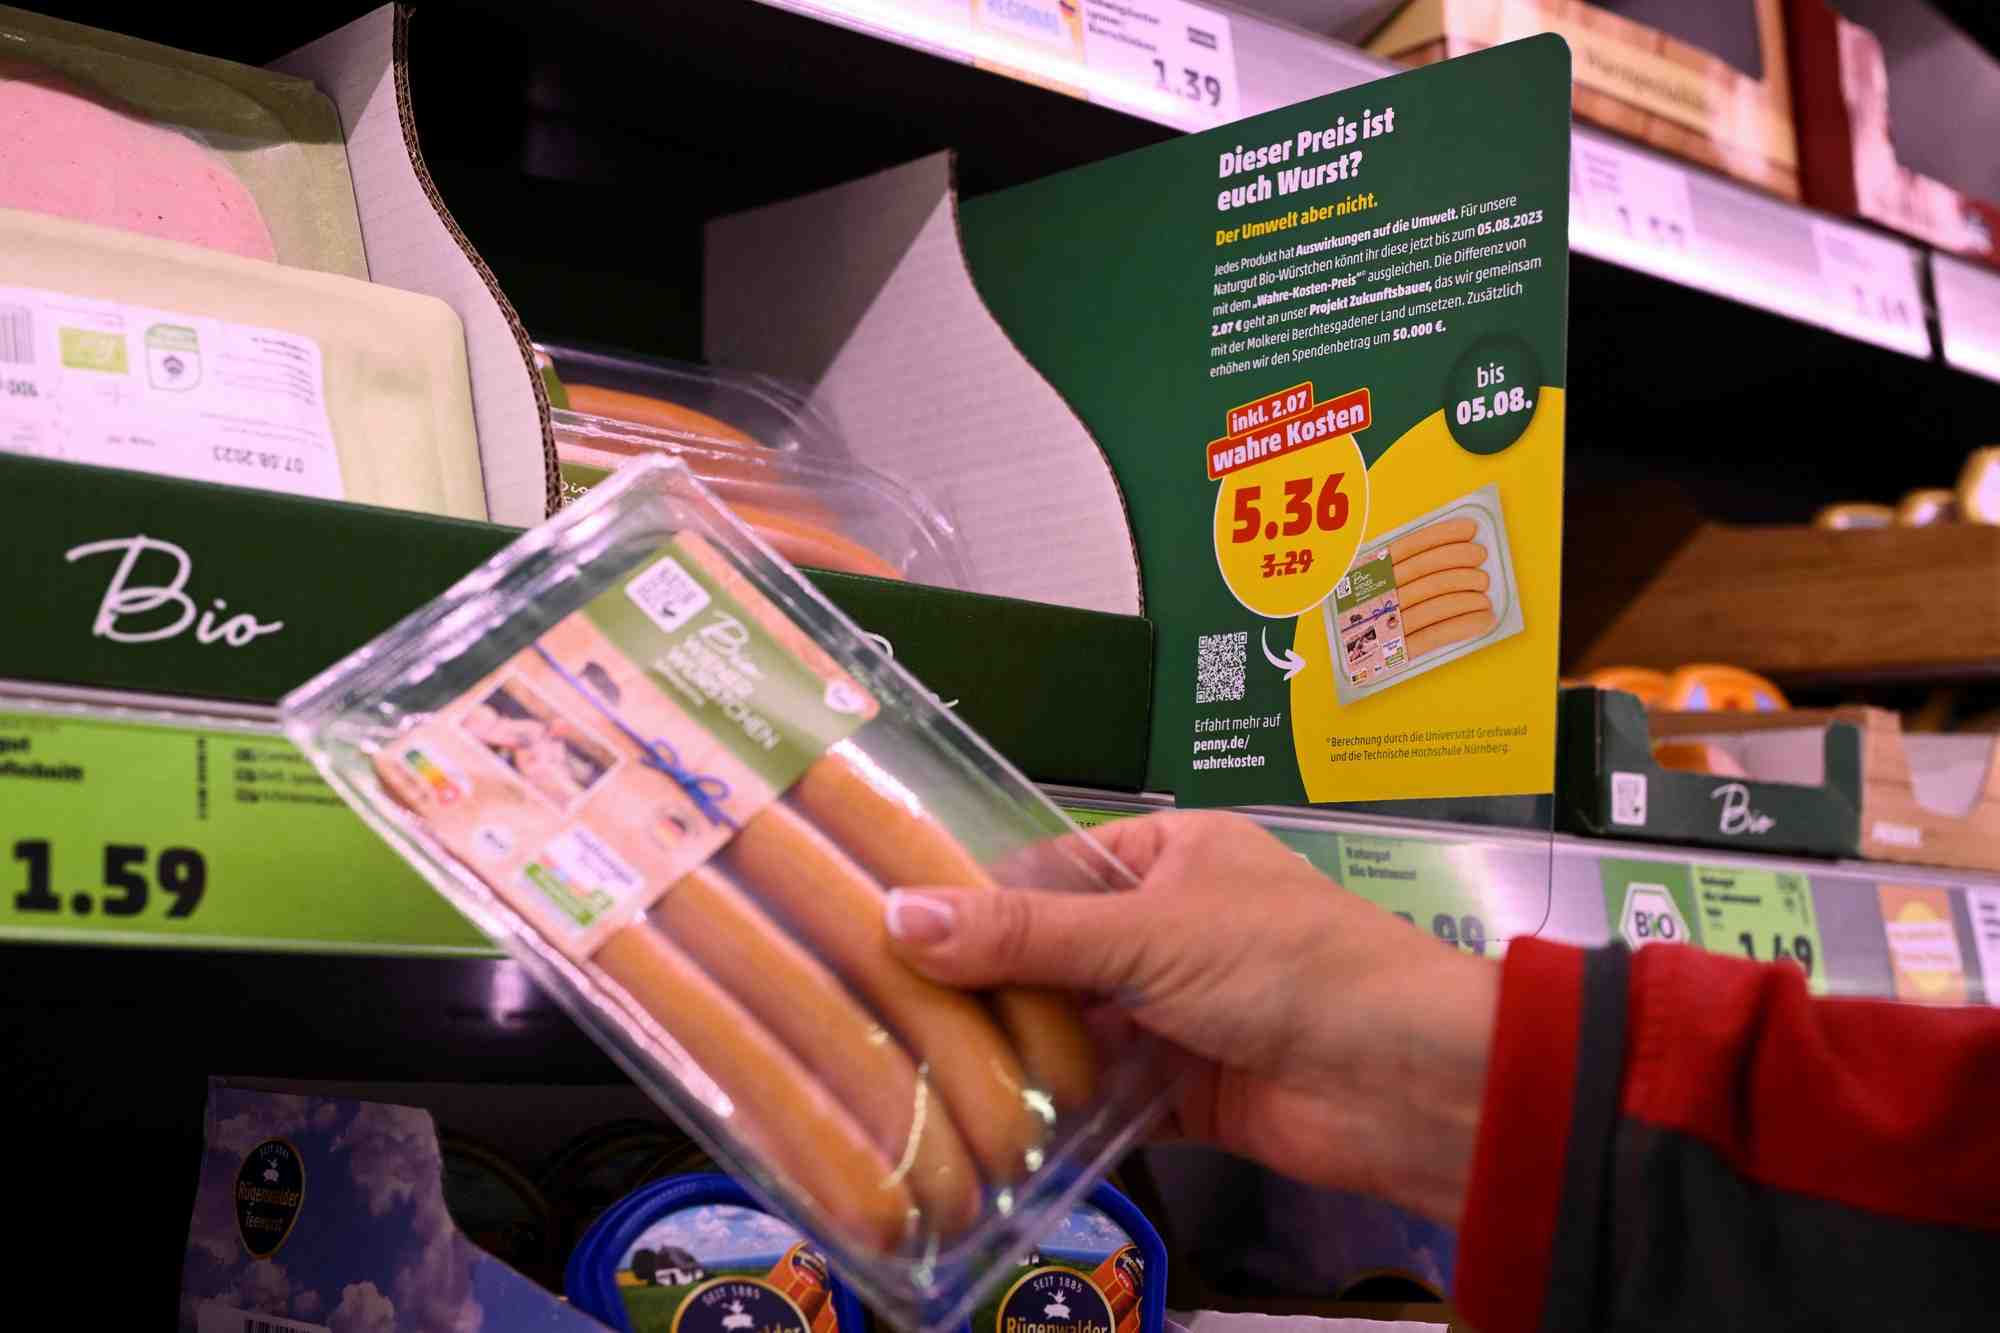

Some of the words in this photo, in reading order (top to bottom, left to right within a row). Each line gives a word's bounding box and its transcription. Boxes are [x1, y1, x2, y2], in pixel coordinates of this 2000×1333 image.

[1153, 58, 1222, 107] 1.39
[1219, 145, 1293, 178] Dieser
[1297, 116, 1357, 156] Preis
[1362, 107, 1395, 139] ist
[1217, 174, 1272, 211] euch
[1278, 151, 1363, 195] Wurst?
[1215, 262, 1239, 277] Jedes
[1241, 252, 1278, 270] Produkt
[1279, 247, 1294, 261] hat
[1296, 231, 1370, 257] Auswirkungen
[1373, 224, 1391, 240] auf
[1393, 219, 1409, 234] die
[1411, 208, 1459, 230] Umwelt.
[1461, 203, 1478, 218] Für
[1480, 195, 1517, 214] unsere
[1216, 228, 1239, 246] Der
[1242, 212, 1298, 239] Umwelt
[1301, 204, 1335, 225] aber
[1337, 192, 1378, 215] nicht.
[1212, 302, 1229, 317] mit
[1230, 298, 1251, 313] dem
[1368, 260, 1432, 282] ausgleichen.
[1434, 254, 1452, 268] Die
[1454, 242, 1504, 263] Differenz
[1505, 238, 1527, 253] von
[1214, 275, 1257, 297] Naturgut
[1259, 258, 1333, 287] Bio-Würstchen
[1334, 250, 1363, 268] könnt
[1365, 247, 1378, 261] ihr
[1381, 242, 1411, 258] diese
[1409, 236, 1432, 254] jetzt
[1435, 231, 1450, 246] bis
[1452, 227, 1475, 242] zum
[1477, 210, 1543, 236] 05.08.2023
[1211, 321, 1234, 337] 2.07
[1235, 319, 1243, 332] €
[1243, 315, 1265, 333] geht
[1266, 313, 1279, 325] an
[1281, 306, 1308, 322] unser
[1309, 295, 1348, 317] Projekt
[1350, 280, 1432, 308] Zukunftsbauer,
[1434, 275, 1453, 289] das
[1455, 269, 1474, 285] wir
[1475, 257, 1542, 284] gemeinsam
[1211, 343, 1227, 357] mit
[1228, 339, 1246, 353] der
[1247, 331, 1290, 351] Molkerei
[1292, 312, 1378, 341] Berchtesgadener
[1381, 304, 1406, 322] Land
[1408, 296, 1465, 317] umsetzen.
[1467, 281, 1523, 305] Zusätzlich
[1210, 357, 1250, 378] erhöhen
[1252, 354, 1271, 369] wir
[1271, 350, 1290, 365] den
[1292, 335, 1370, 363] Spendenbetrag
[1373, 332, 1390, 345] um
[1393, 321, 1433, 341] 50.000
[1435, 319, 1446, 333] €.
[1476, 362, 1505, 388] bis
[1232, 405, 1269, 434] inkl.
[1272, 390, 1307, 418] 2.07
[1456, 386, 1533, 425] 05.08.
[1213, 434, 1281, 473] wahre
[1286, 404, 1365, 447] Kosten
[1231, 472, 1350, 545] 5.36
[65, 535, 284, 646] Bio
[1261, 549, 1314, 578] 3.29
[1193, 735, 1250, 754] penny.de/
[1194, 717, 1230, 733] Erfahrt
[1232, 715, 1260, 730] mehr
[1263, 713, 1281, 728] auf
[1383, 732, 1408, 745] durch
[1410, 731, 1424, 742] die
[1425, 727, 1475, 742] Universität
[1193, 754, 1265, 770] wahrekosten
[1330, 752, 1346, 762] und
[1348, 751, 1361, 761] die
[1363, 748, 1409, 761] Technische
[1410, 743, 1462, 758] Hochschule
[1710, 783, 1777, 834] Bio
[12, 839, 209, 920] 1.59
[1033, 1275, 1054, 1291] SEIT
[1059, 1276, 1082, 1293] 1885
